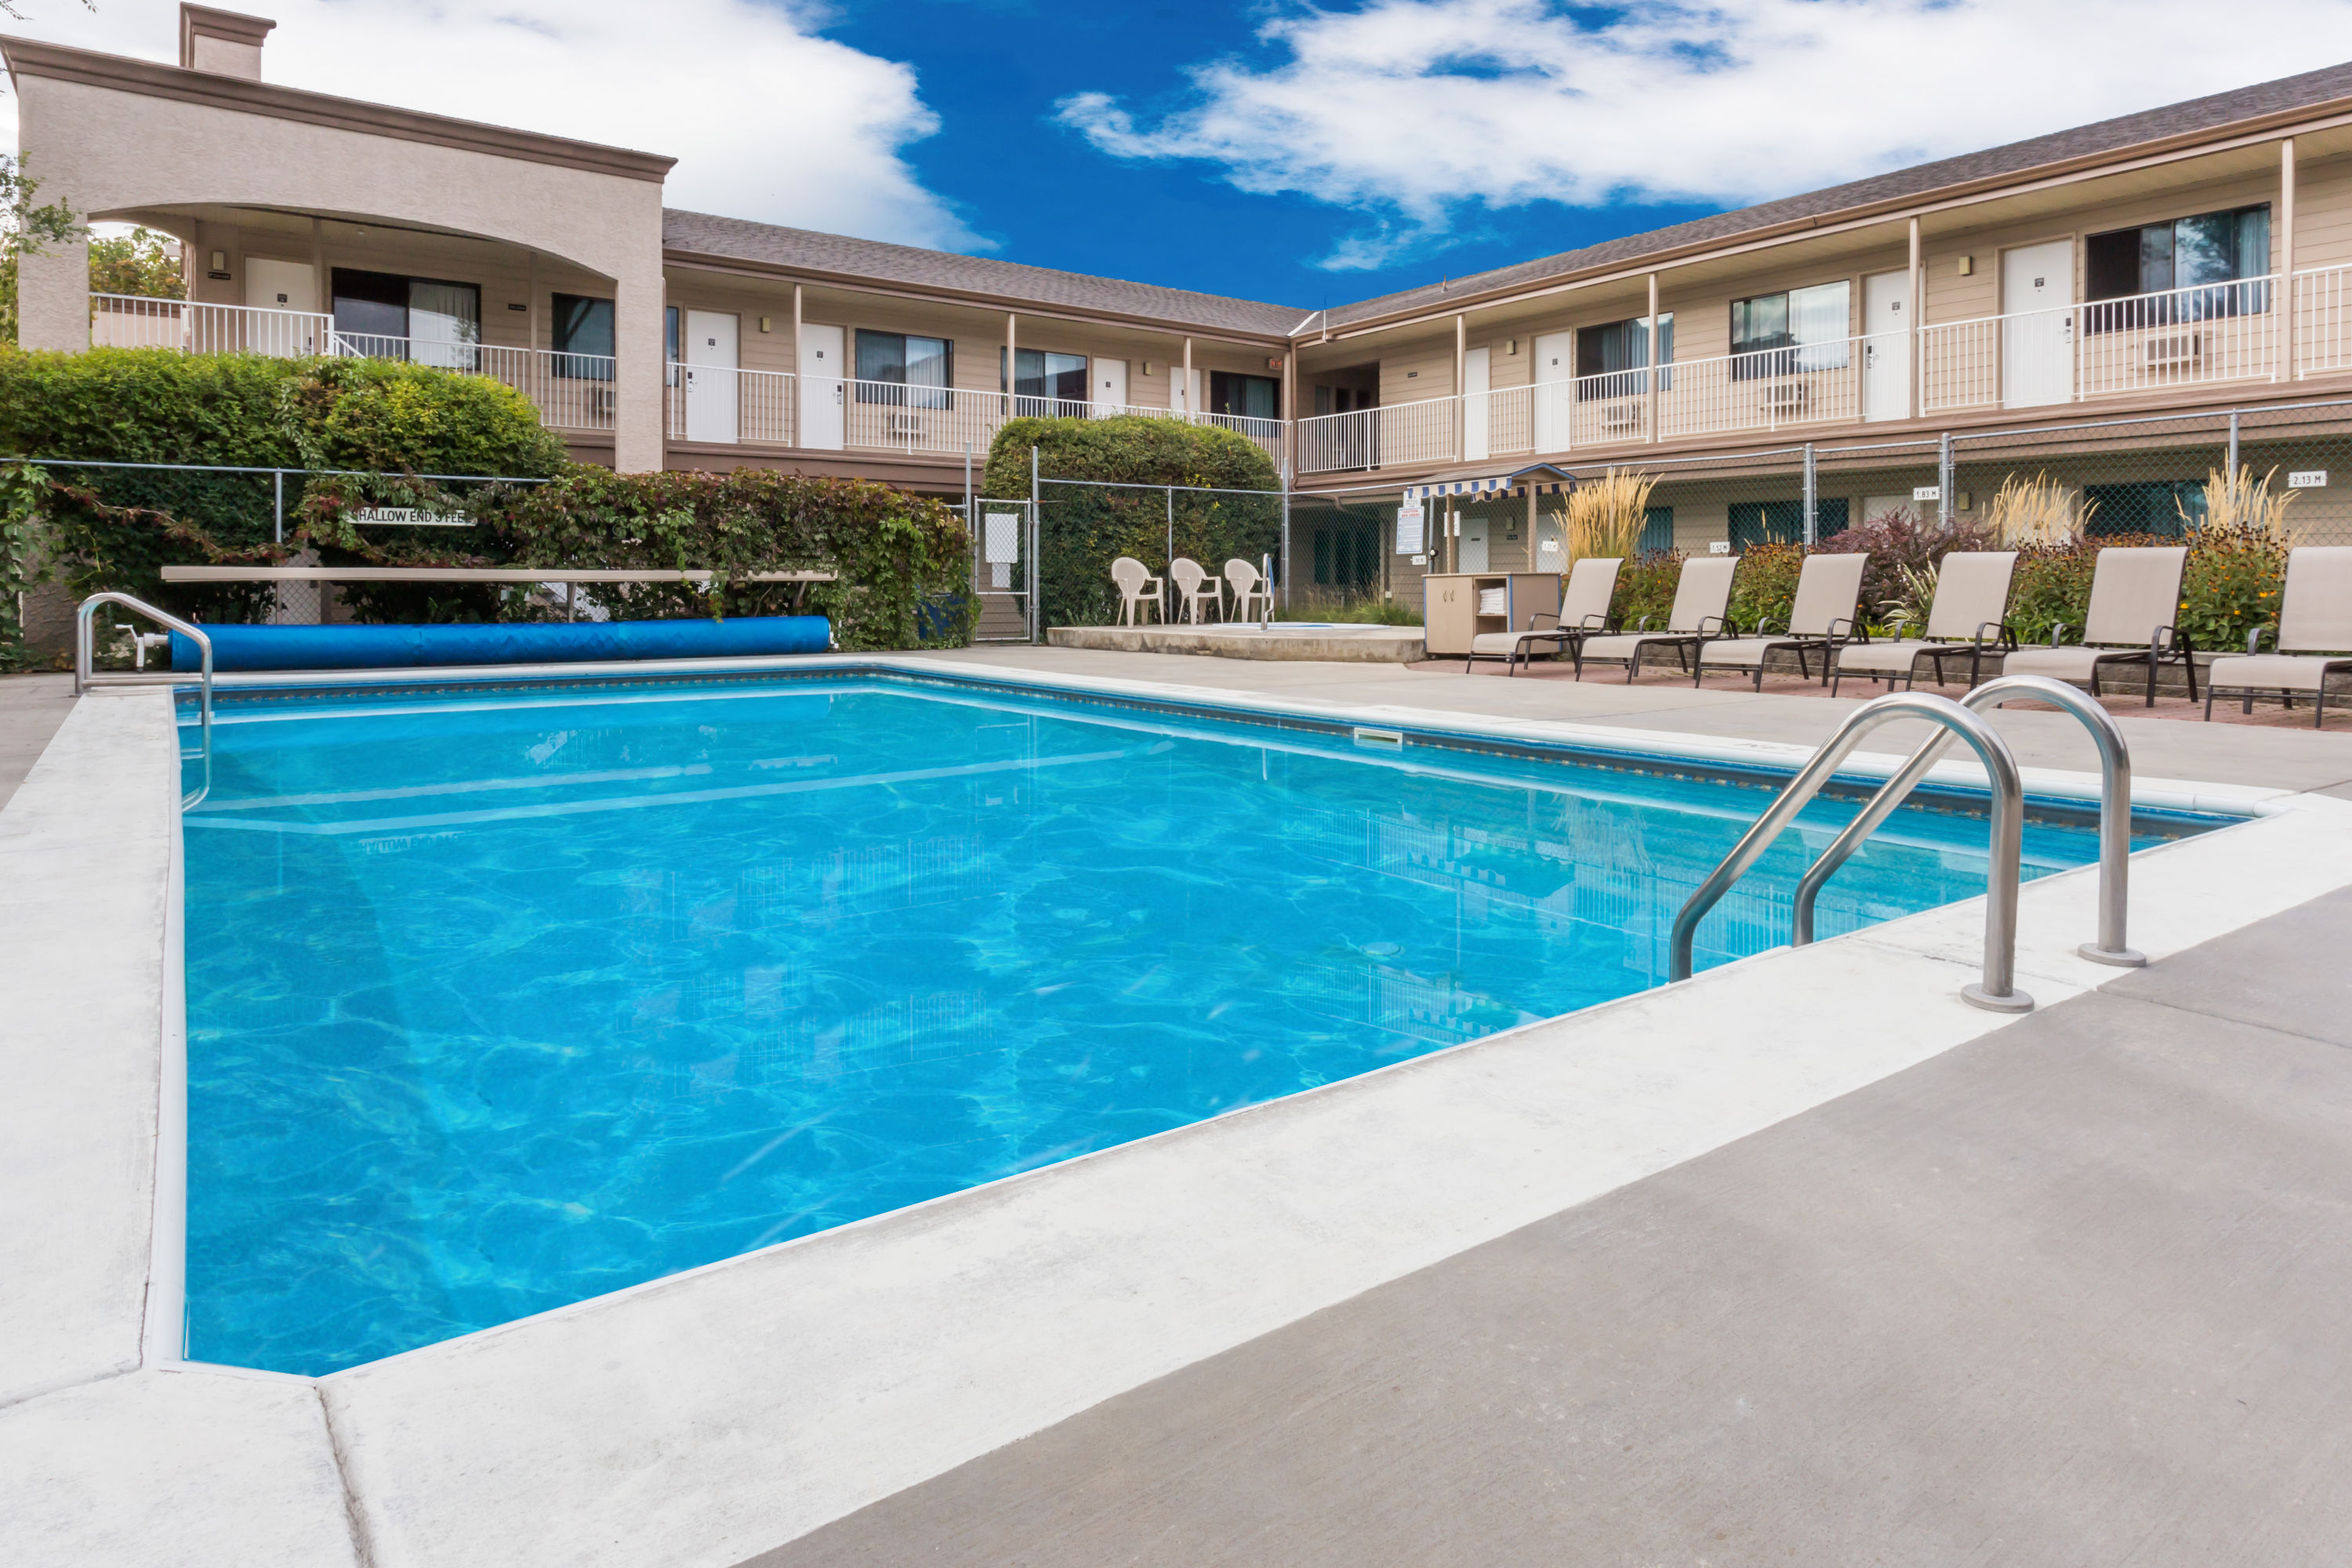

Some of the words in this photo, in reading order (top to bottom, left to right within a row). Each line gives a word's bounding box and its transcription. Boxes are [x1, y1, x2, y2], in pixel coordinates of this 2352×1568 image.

[2293, 476, 2311, 485] 2.13
[2314, 475, 2321, 484] M
[410, 511, 432, 522] END
[445, 513, 470, 523] FEE
